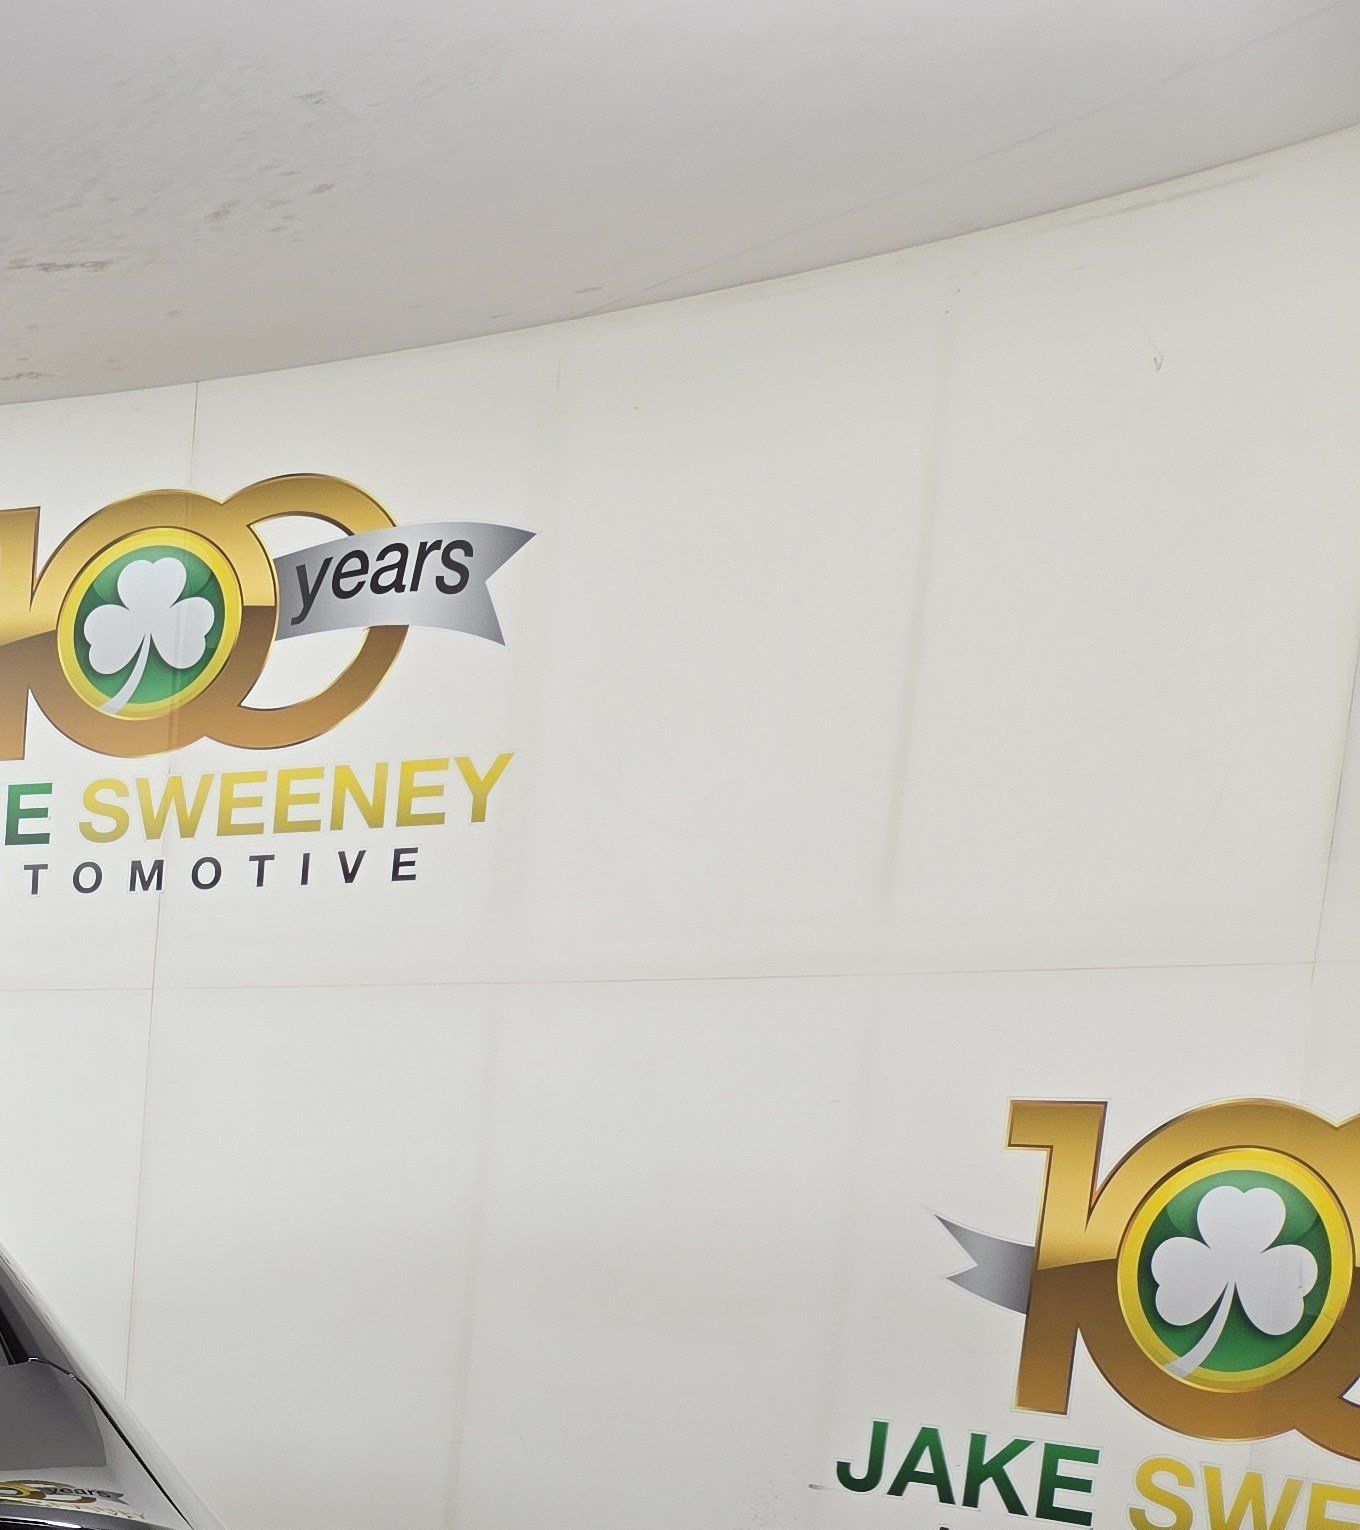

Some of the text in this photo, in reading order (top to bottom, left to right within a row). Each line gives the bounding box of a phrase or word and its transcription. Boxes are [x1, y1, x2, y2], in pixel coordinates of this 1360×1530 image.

[290, 538, 474, 626] years
[78, 752, 514, 843] SWEENEY
[836, 1420, 1100, 1527] JAKE
